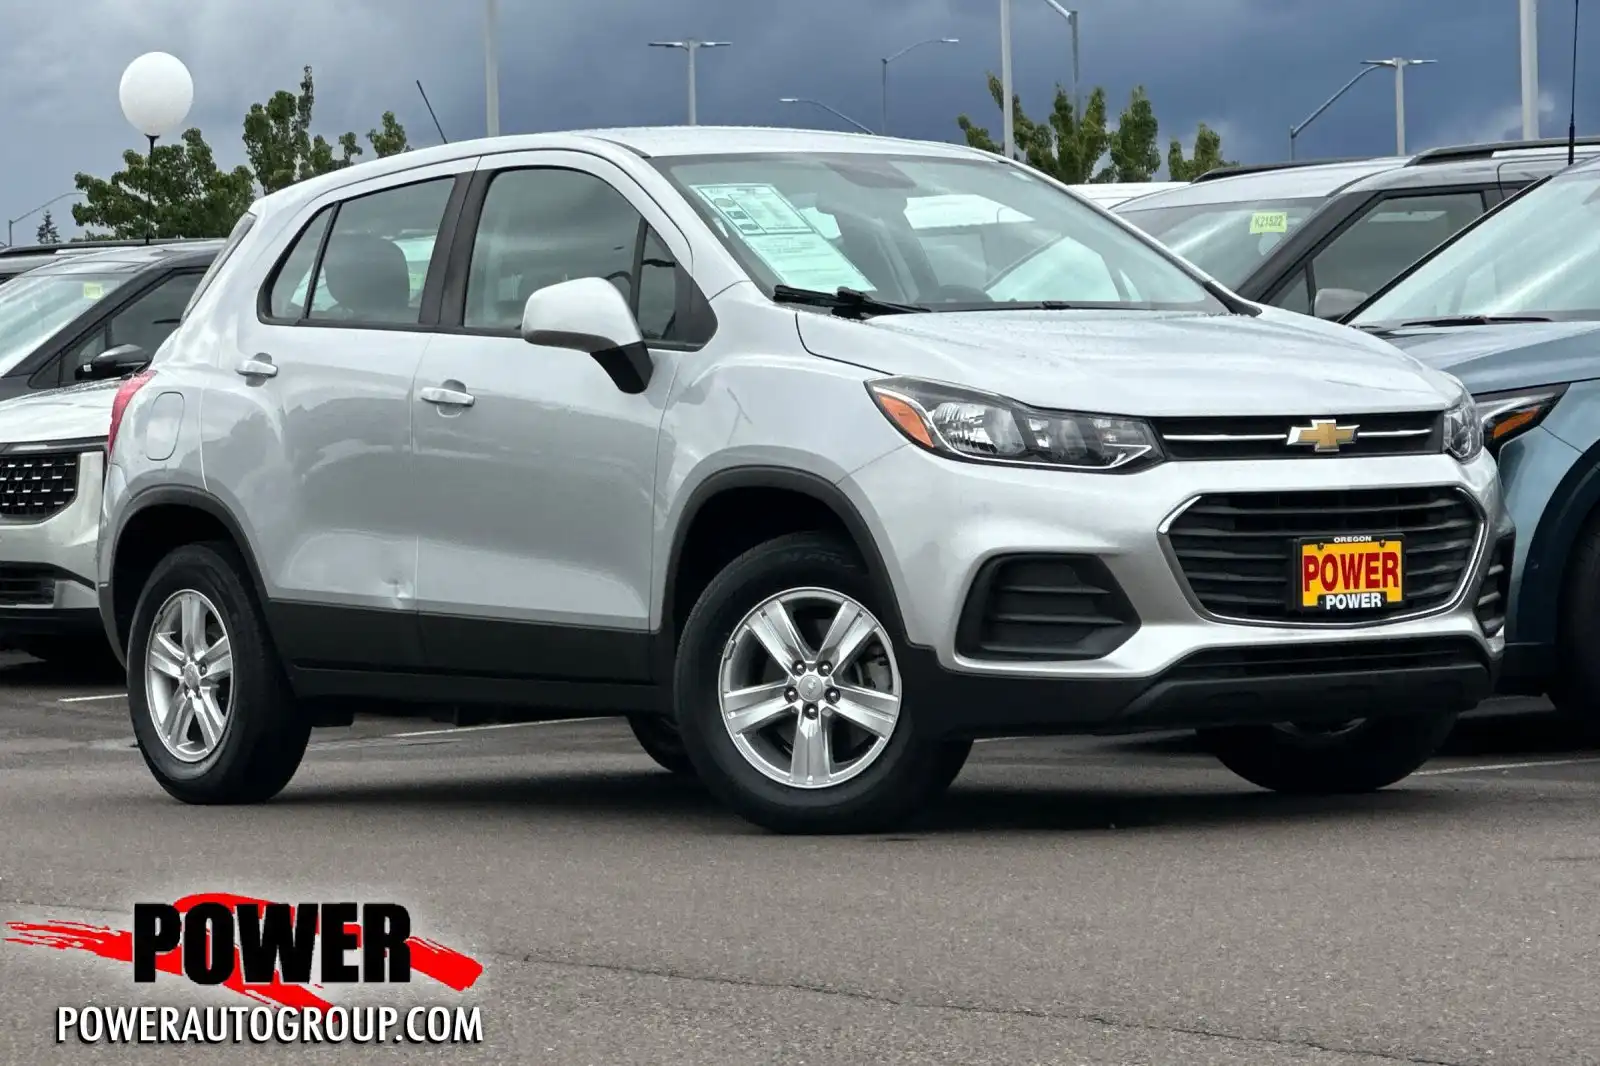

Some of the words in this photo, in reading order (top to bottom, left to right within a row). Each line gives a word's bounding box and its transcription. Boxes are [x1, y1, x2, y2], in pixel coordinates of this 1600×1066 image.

[1333, 535, 1372, 543] OREGON
[1303, 551, 1399, 592] POWER
[1325, 592, 1382, 610] POWER
